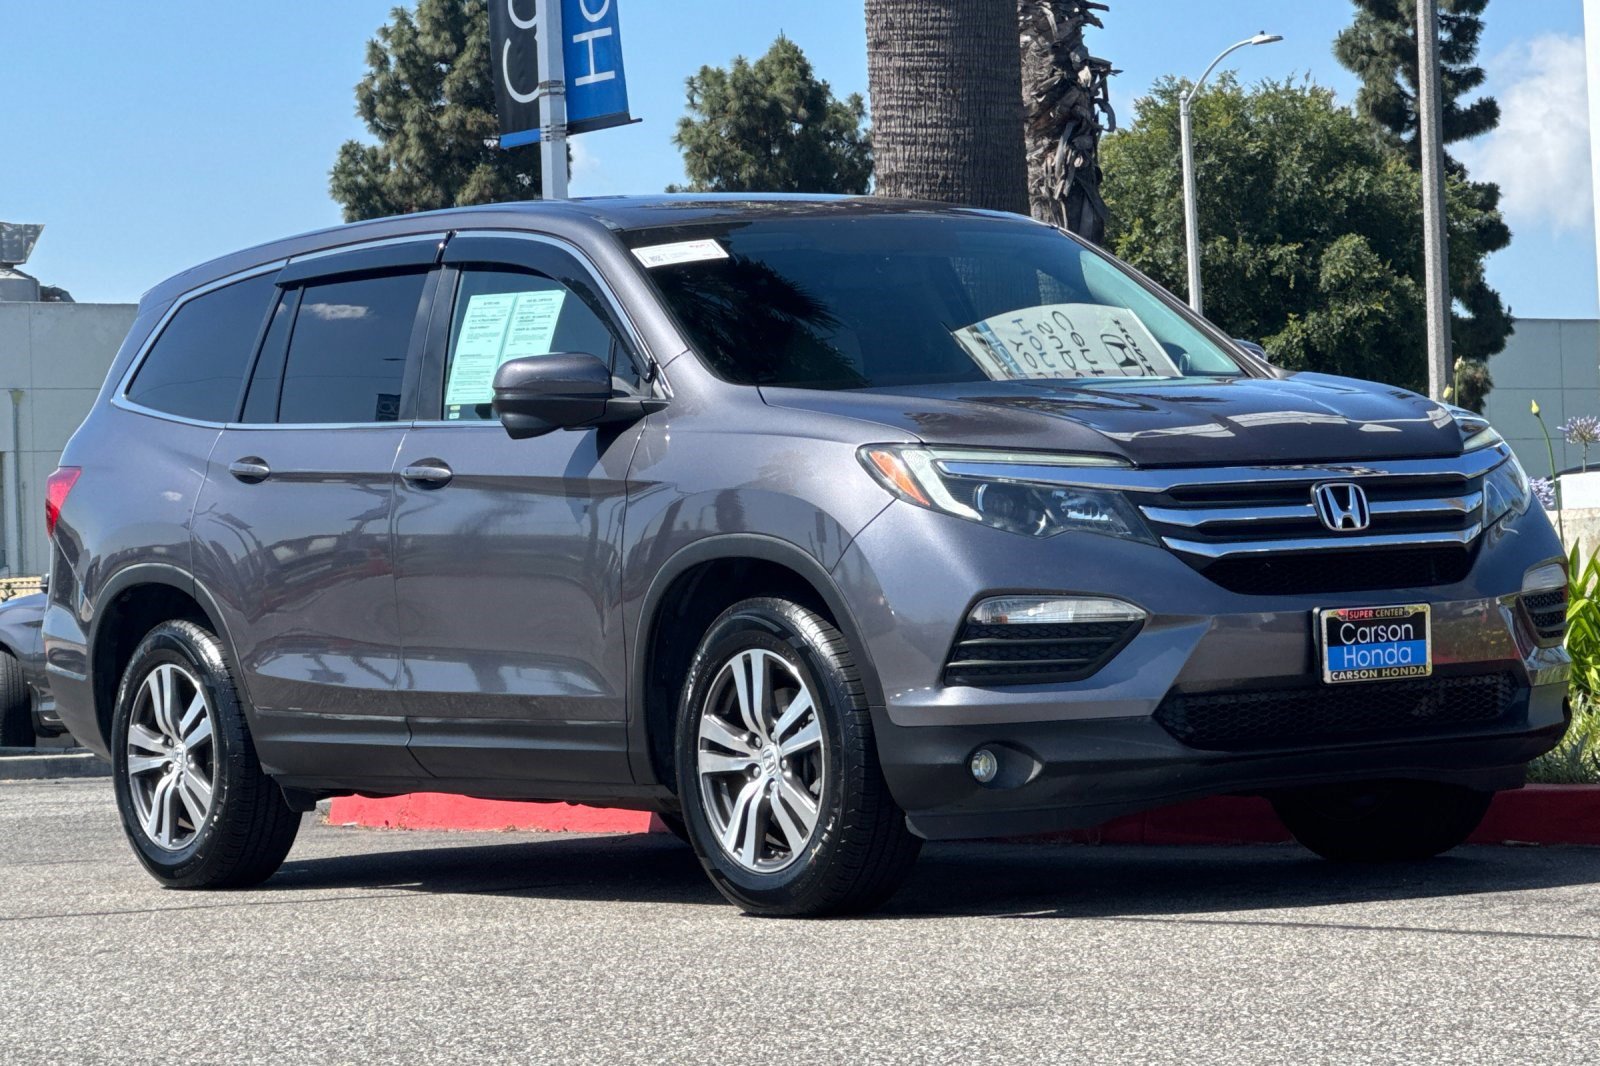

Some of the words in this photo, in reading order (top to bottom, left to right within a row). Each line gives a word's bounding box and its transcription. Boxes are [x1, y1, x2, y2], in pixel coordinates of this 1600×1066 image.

[1349, 609, 1374, 619] SUPER
[1375, 608, 1404, 618] CENTER
[1339, 622, 1414, 645] Carson
[1343, 642, 1412, 668] Honda
[1331, 669, 1378, 681] CARSON
[1381, 665, 1426, 677] HONDA
